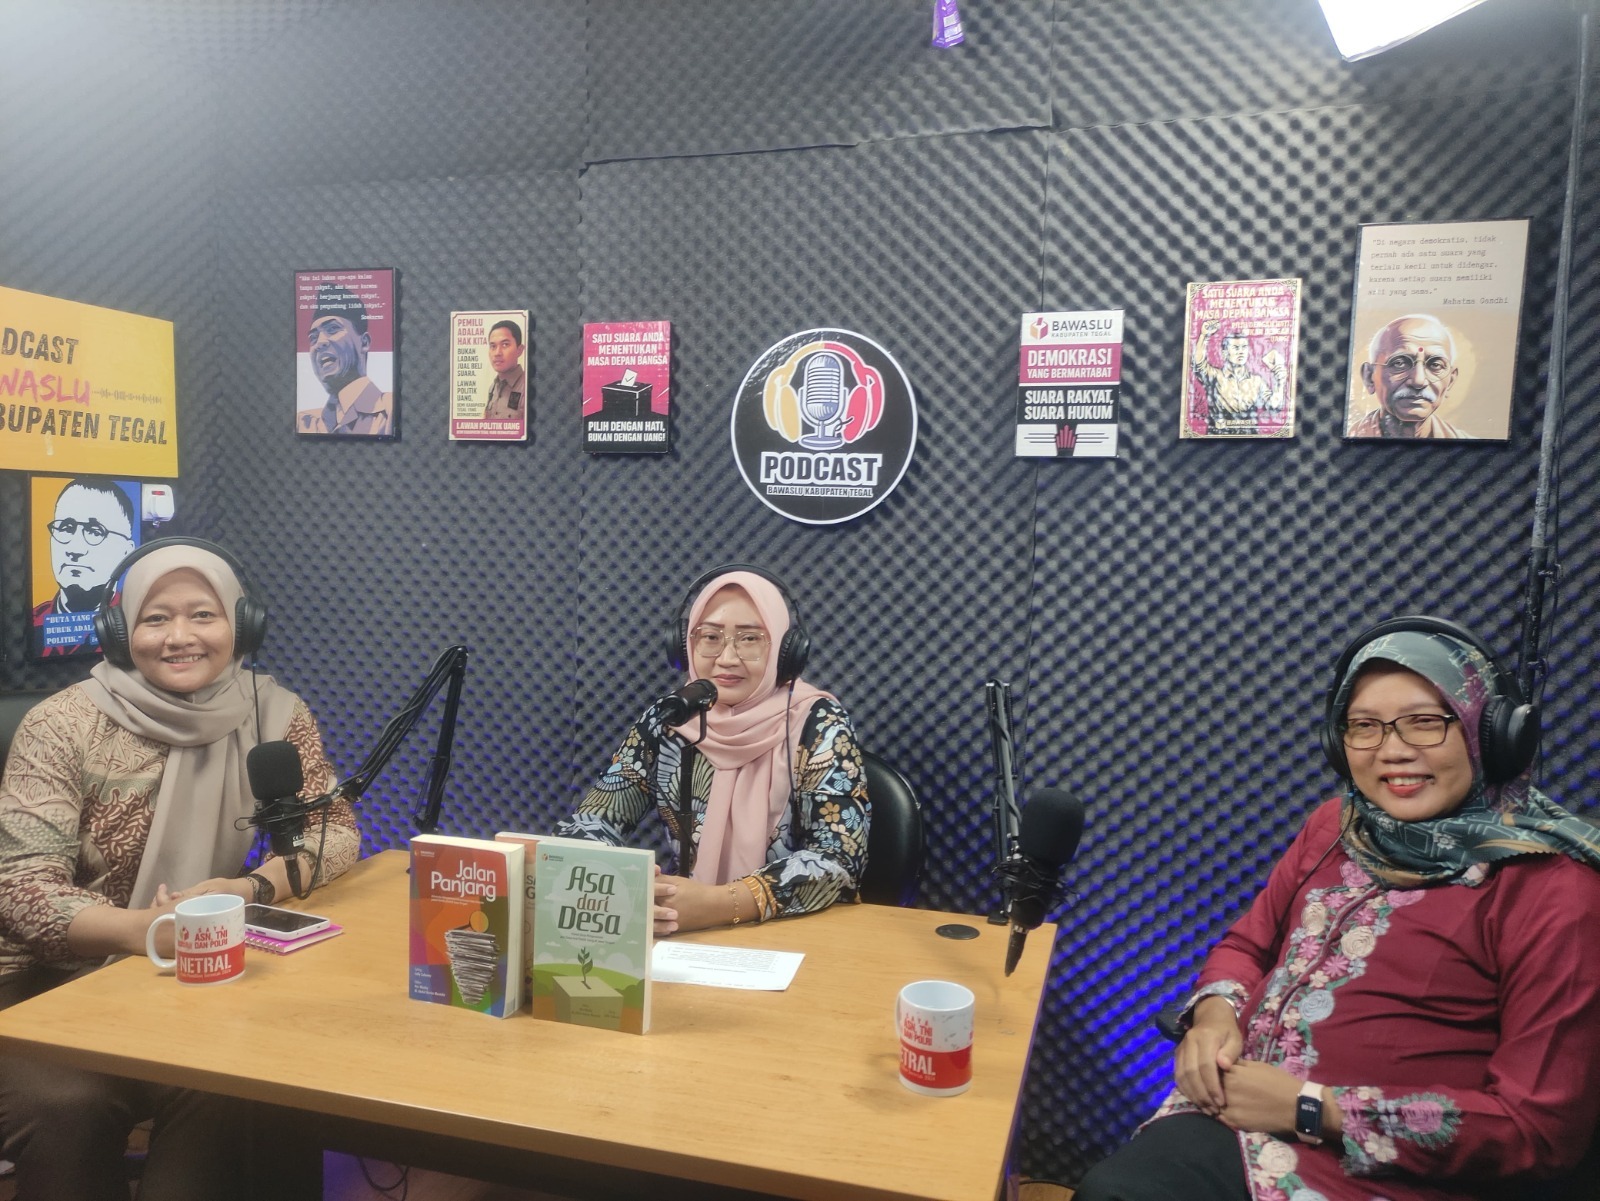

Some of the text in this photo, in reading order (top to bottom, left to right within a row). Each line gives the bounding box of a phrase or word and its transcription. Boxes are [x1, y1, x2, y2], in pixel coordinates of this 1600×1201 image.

[1389, 239, 1415, 247] negara
[1474, 235, 1497, 243] tidak
[1371, 251, 1397, 259] pernah
[1467, 249, 1486, 257] yang
[1404, 262, 1426, 270] kecil
[1399, 276, 1426, 284] setiap
[1202, 288, 1225, 298] SATU
[1258, 286, 1285, 296] ANDA
[1389, 288, 1407, 296] yang
[1194, 309, 1220, 320] MASA
[1222, 308, 1254, 318] DEPAN
[457, 318, 484, 327] PEMILU
[1052, 319, 1113, 332] BAWASLU
[457, 328, 484, 336] ADALAH
[457, 337, 488, 346] HAK KITA
[592, 332, 665, 344] SATU SUARA ANDA
[1, 327, 79, 365] DCAST
[598, 344, 658, 355] MENENTUKAN
[588, 355, 668, 366] MASA DEPAN BANGSA
[1027, 348, 1112, 366] DEMOKRASI
[457, 362, 482, 370] JUAL BELI
[1027, 367, 1112, 378] YANG BERMARTABAT
[1024, 389, 1114, 405] SUARA RAKYAT,
[1024, 405, 1113, 420] SUARA HUKUM
[108, 415, 168, 445] TEGAL
[456, 422, 520, 430] LAWAN POLITIK UANG
[588, 421, 666, 433] PILIH DENGAN HATI,
[588, 432, 666, 442] BUKAN DENGAN UANG!
[762, 453, 881, 484] PODCAST
[767, 486, 873, 497] BAWASLU KABUPATEN TEGAL
[71, 614, 90, 622] YANG
[46, 626, 72, 634] BURUK
[456, 859, 496, 884] Jalan
[431, 870, 497, 903] Panjang
[566, 866, 615, 896] Asa
[577, 893, 610, 912] dari
[558, 905, 621, 936] Desa
[216, 930, 228, 939] TNI
[210, 938, 228, 948] POLRI
[180, 954, 232, 974] NETRAL
[920, 1025, 933, 1036] TNI
